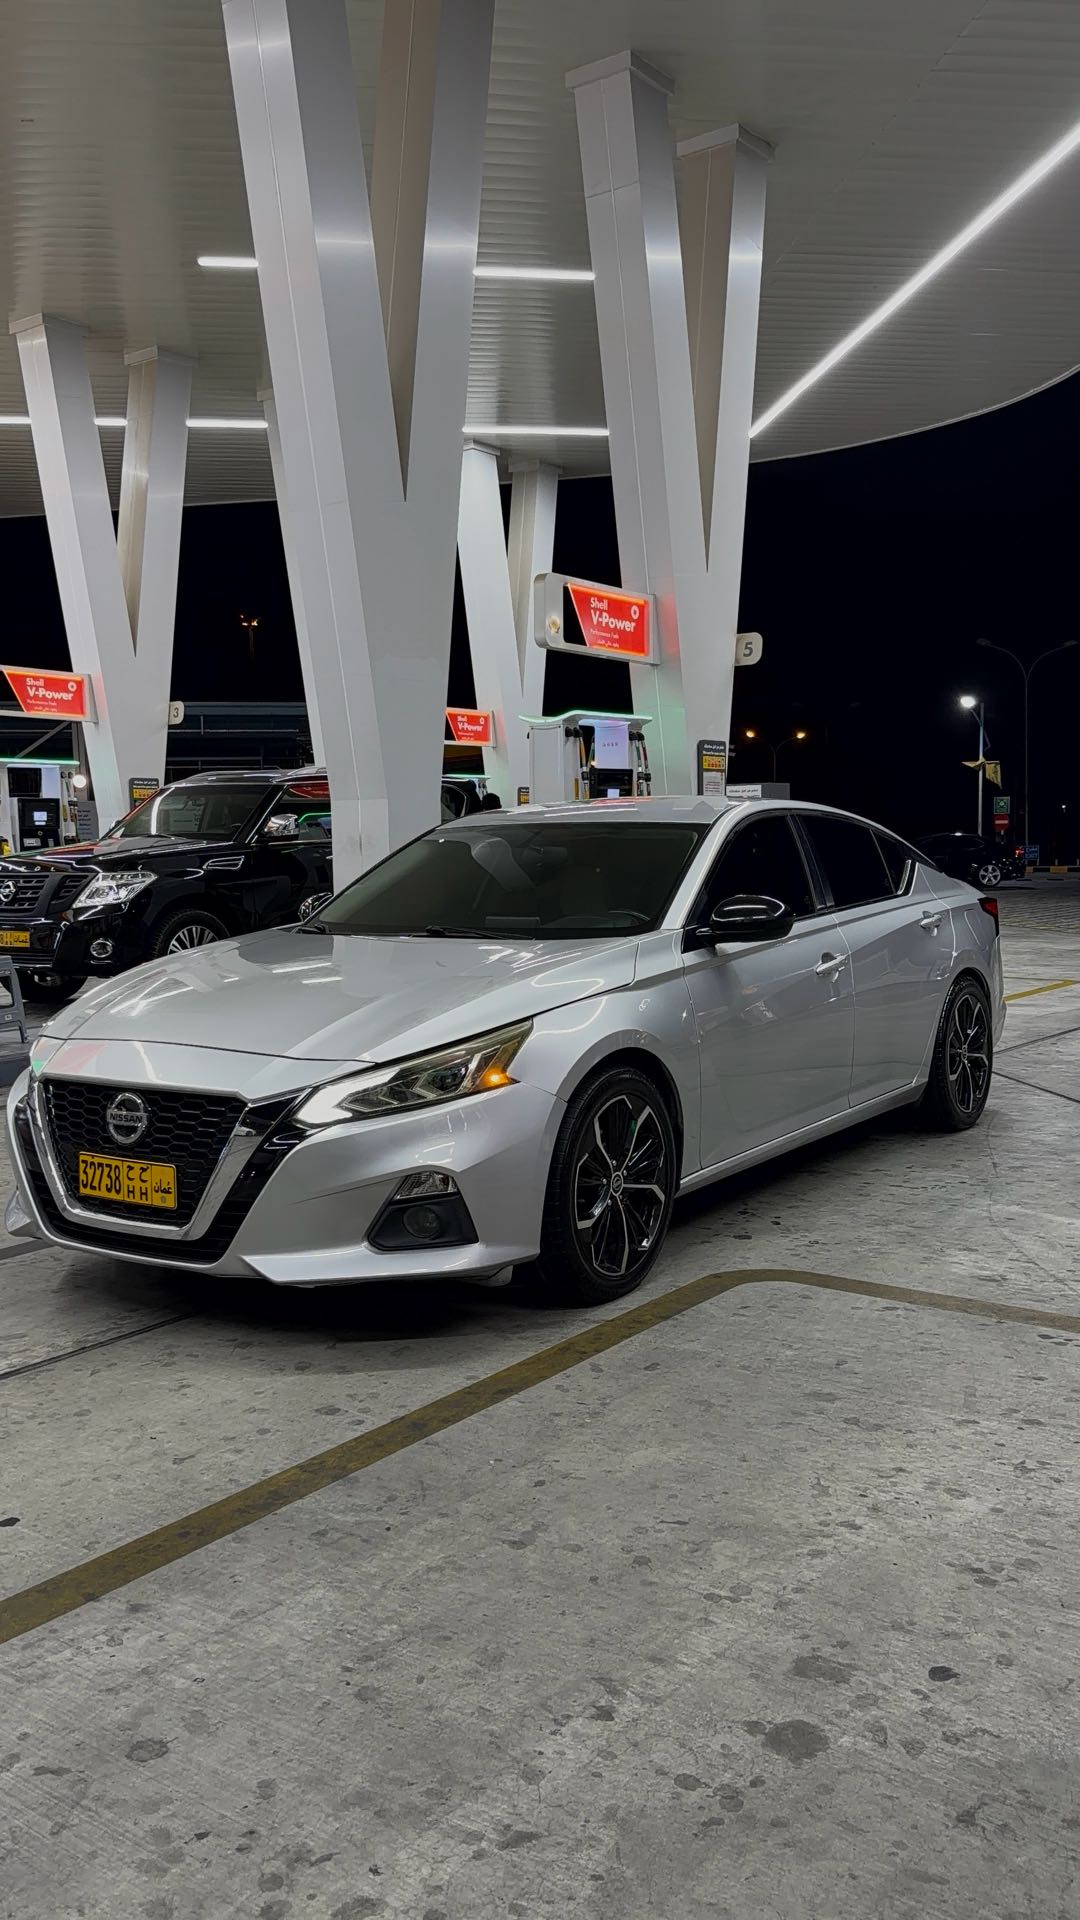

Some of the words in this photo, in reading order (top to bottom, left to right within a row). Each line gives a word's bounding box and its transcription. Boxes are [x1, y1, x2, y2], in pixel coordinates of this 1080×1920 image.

[590, 597, 608, 610] Shell
[591, 609, 636, 632] V-Power
[743, 641, 753, 657] 5
[26, 677, 45, 687] Shell
[26, 686, 74, 700] V-Power
[173, 706, 179, 718] 3
[110, 1112, 143, 1123] NISSAN
[81, 1159, 121, 1195] 32738
[127, 1185, 135, 1200] H
[140, 1186, 148, 1201] H
